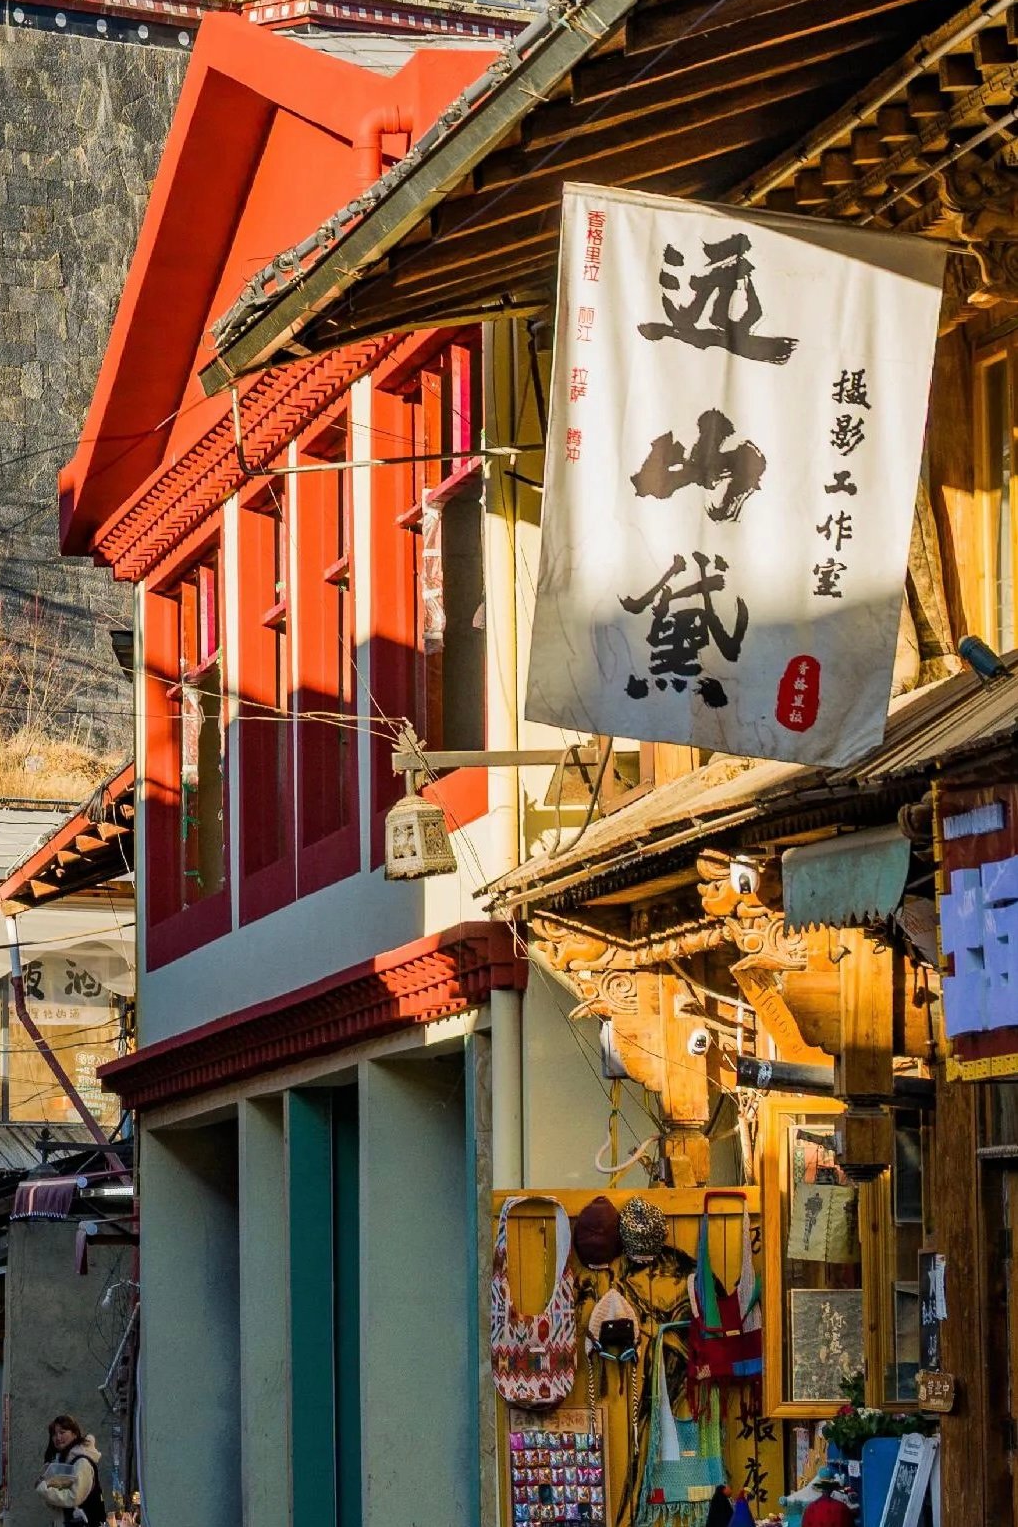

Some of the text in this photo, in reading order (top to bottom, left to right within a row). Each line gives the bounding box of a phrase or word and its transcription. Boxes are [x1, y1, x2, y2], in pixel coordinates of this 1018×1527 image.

[582, 209, 606, 283] 香格里拉
[576, 306, 595, 343] 丽江
[569, 366, 589, 403] 拉萨
[617, 233, 800, 709] 远山黛
[812, 368, 873, 599] 摄影工作室
